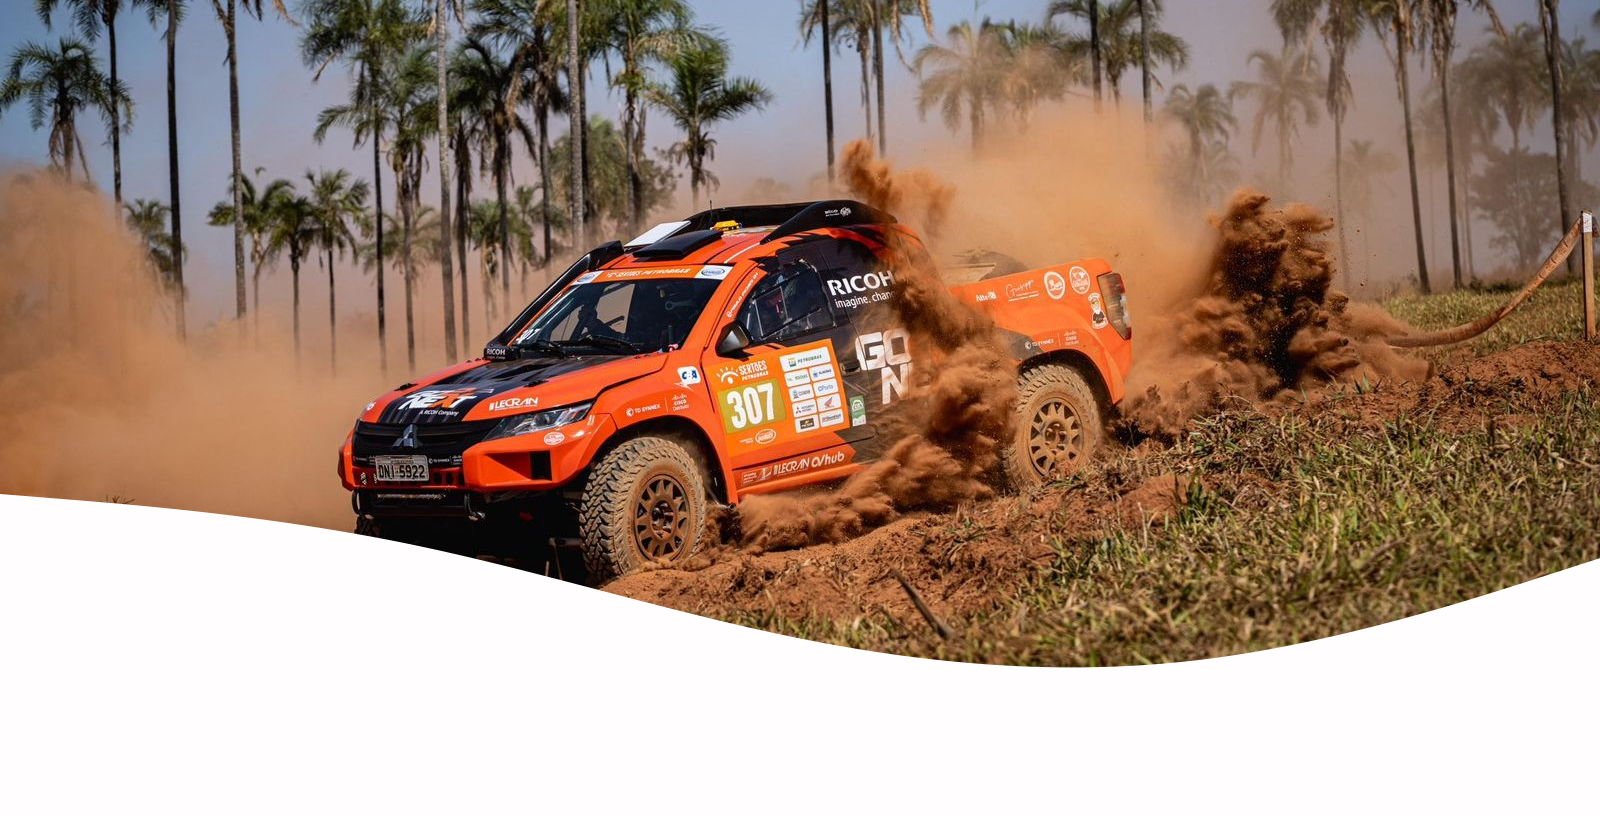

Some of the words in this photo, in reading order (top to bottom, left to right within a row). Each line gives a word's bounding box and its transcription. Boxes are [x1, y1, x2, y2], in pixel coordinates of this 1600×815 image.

[826, 270, 896, 296] RICOH
[834, 294, 872, 309] imagine.
[871, 290, 896, 303] chan
[486, 348, 506, 356] RICOH
[855, 328, 912, 371] GO
[797, 354, 822, 364] PETROBRAS
[738, 360, 768, 376] SERTÕES
[741, 371, 769, 381] PETROBRAS
[494, 397, 539, 410] LECRAN
[726, 382, 775, 429] 307
[777, 457, 810, 474] LECRAN
